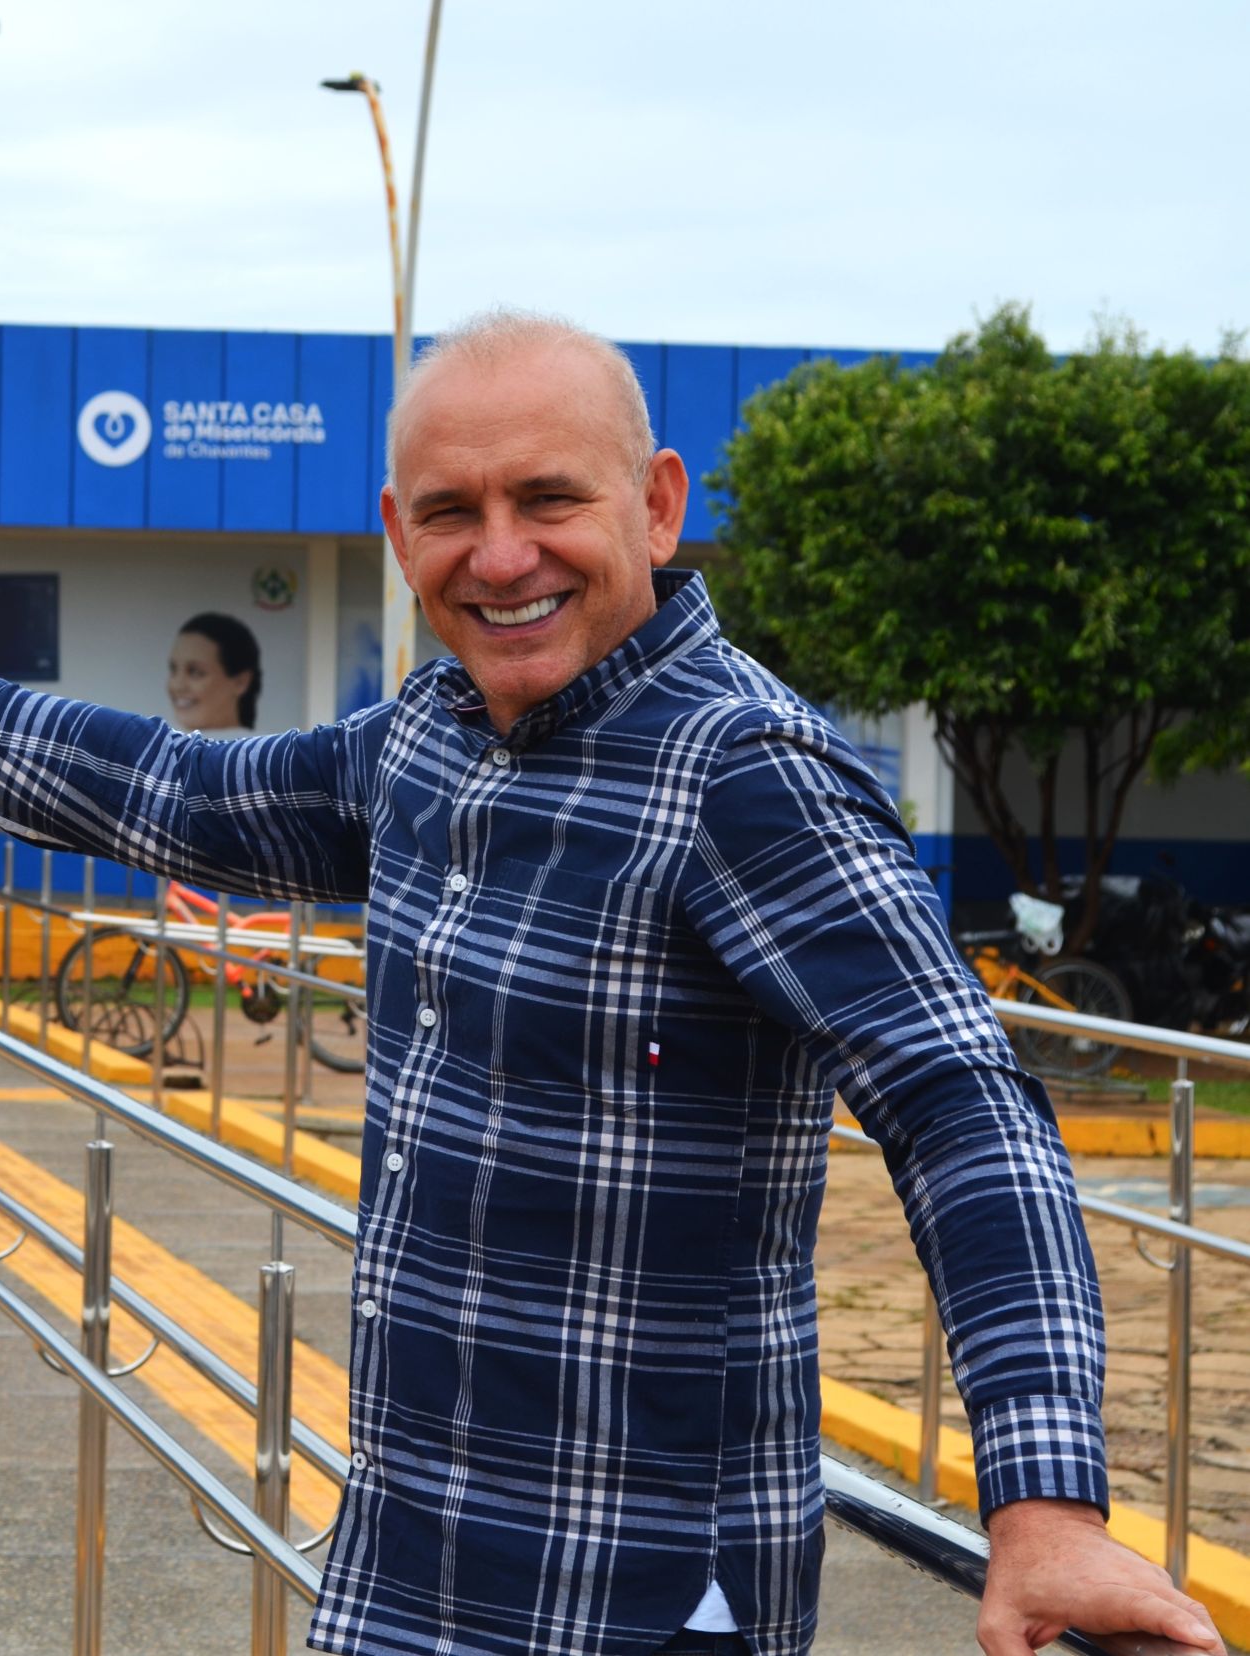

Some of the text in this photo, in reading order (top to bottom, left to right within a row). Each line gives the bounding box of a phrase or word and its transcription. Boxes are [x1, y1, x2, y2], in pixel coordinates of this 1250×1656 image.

[163, 400, 324, 426] SANTA CASA
[163, 424, 192, 442] de
[163, 441, 272, 461] de Chavantes
